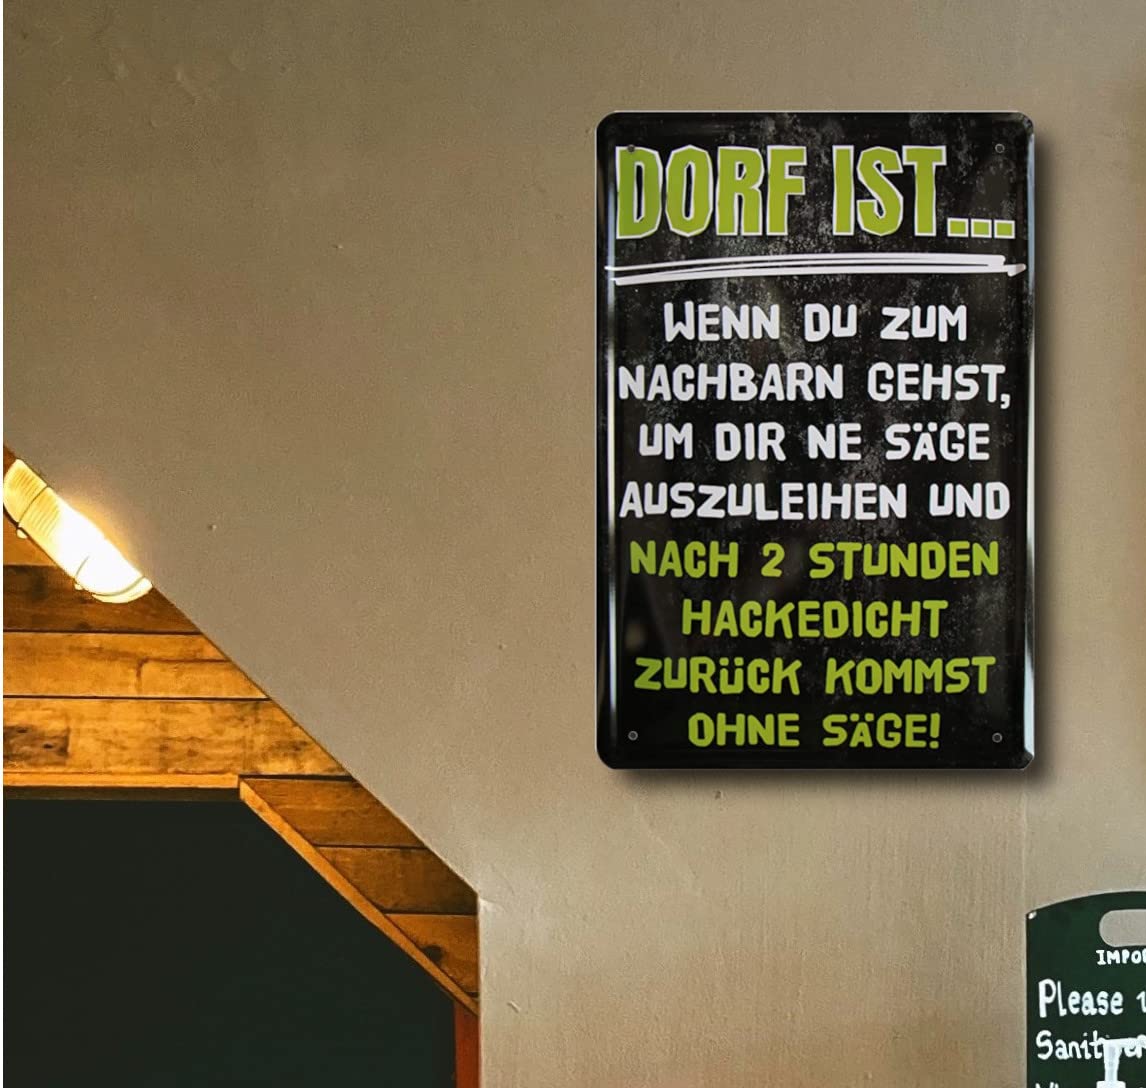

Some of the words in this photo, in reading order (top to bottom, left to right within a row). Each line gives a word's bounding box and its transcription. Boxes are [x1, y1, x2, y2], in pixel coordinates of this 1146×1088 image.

[615, 145, 807, 239] DORF
[832, 145, 1016, 238] IST...
[663, 300, 780, 342] WENN
[804, 302, 858, 342] DU
[880, 304, 967, 342] ZUM
[618, 362, 844, 402] NACHBARN
[867, 362, 1011, 410] GEHST,
[639, 422, 693, 460] UM
[715, 421, 786, 462] DIR
[807, 422, 862, 461] NE
[885, 421, 990, 461] SÄGE
[619, 481, 907, 521] AUSZULEIHEN
[929, 481, 1011, 520] UND
[630, 540, 738, 578] NACH
[761, 542, 785, 577] 2
[809, 541, 999, 580] STUNDEN
[682, 599, 948, 638] HACKEDICHT
[634, 656, 802, 695] ZURÜCK
[825, 656, 996, 694] KOMMST
[688, 713, 800, 747] OHNE
[823, 713, 941, 748] SÄGE!
[1038, 978, 1124, 1019] Please
